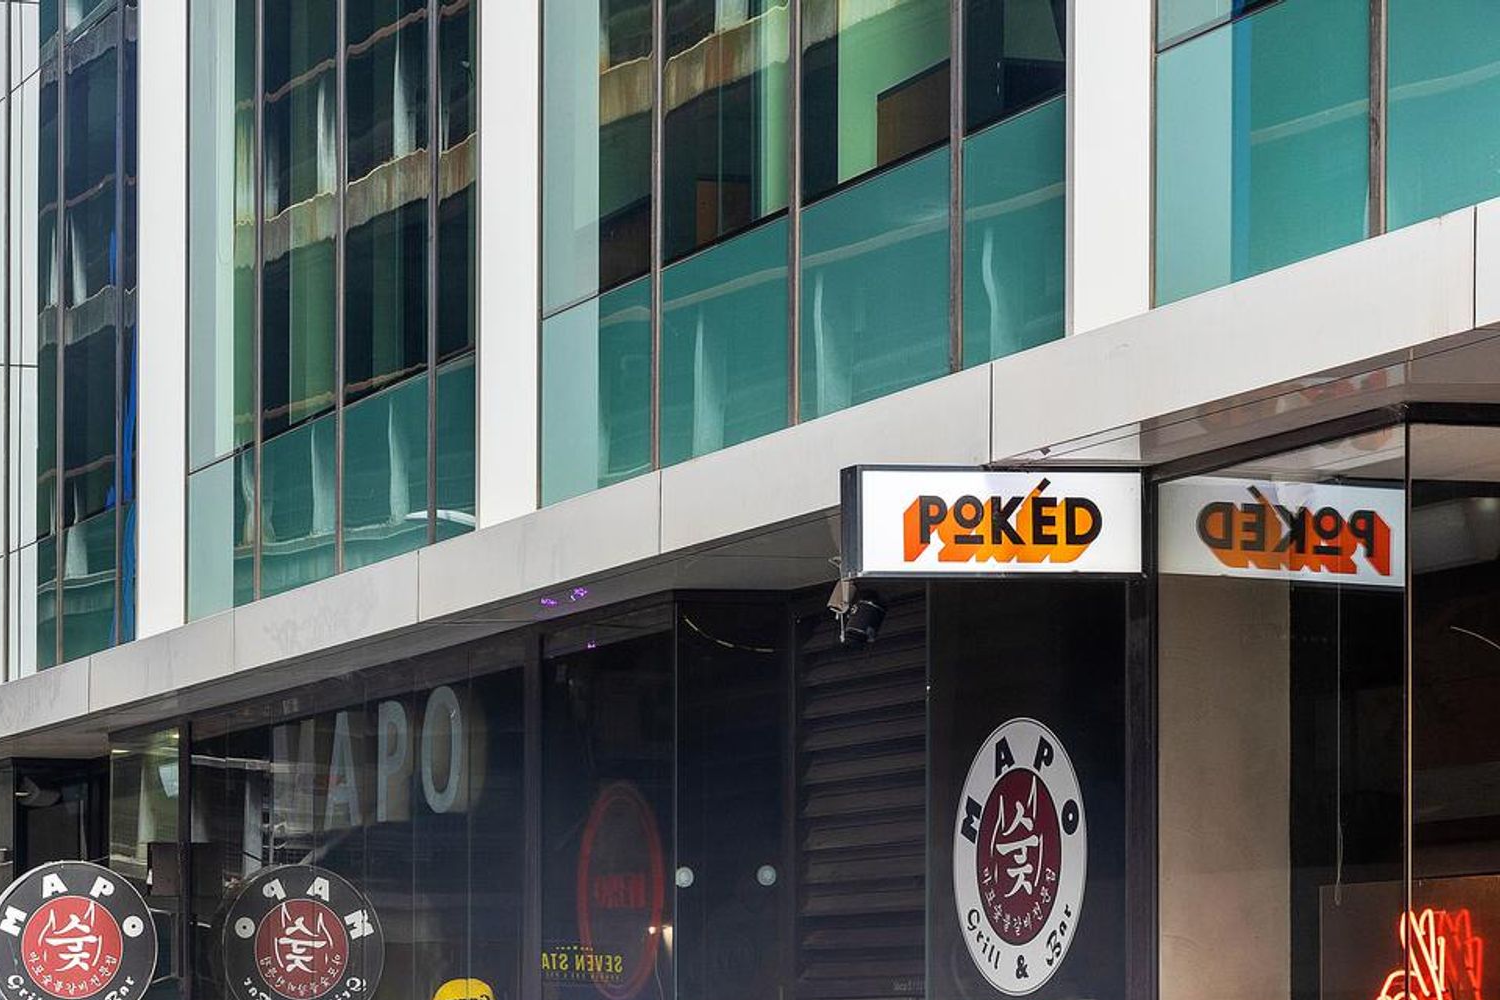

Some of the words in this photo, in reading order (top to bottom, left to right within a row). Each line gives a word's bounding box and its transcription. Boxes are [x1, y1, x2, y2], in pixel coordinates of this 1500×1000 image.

[961, 735, 1080, 844] MAPO
[0, 873, 145, 938] MAPO
[967, 908, 1001, 970] Grill
[1015, 955, 1030, 980] &
[1046, 904, 1072, 967] Bar
